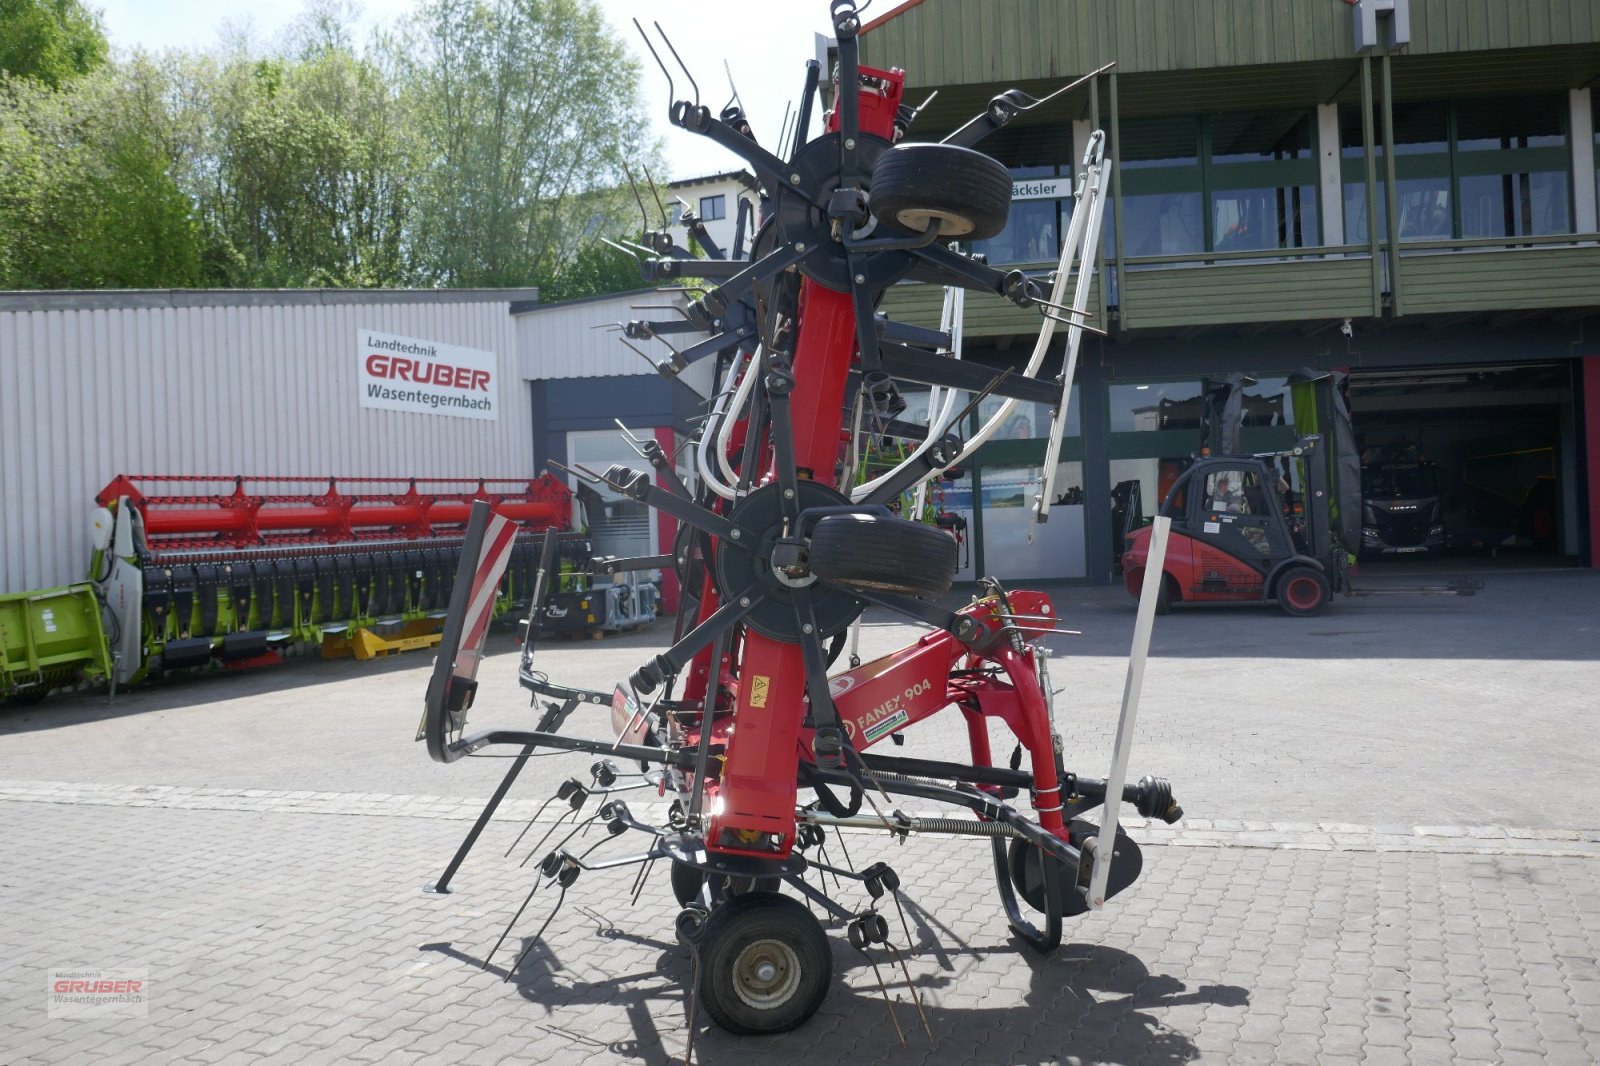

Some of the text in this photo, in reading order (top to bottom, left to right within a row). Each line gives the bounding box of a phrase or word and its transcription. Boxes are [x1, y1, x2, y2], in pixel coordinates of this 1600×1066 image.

[367, 336, 437, 358] Landtechnik
[365, 354, 491, 392] GRUBER
[367, 383, 492, 411] Wasentegernbach
[857, 695, 901, 729] FANEX
[904, 678, 931, 701] 904
